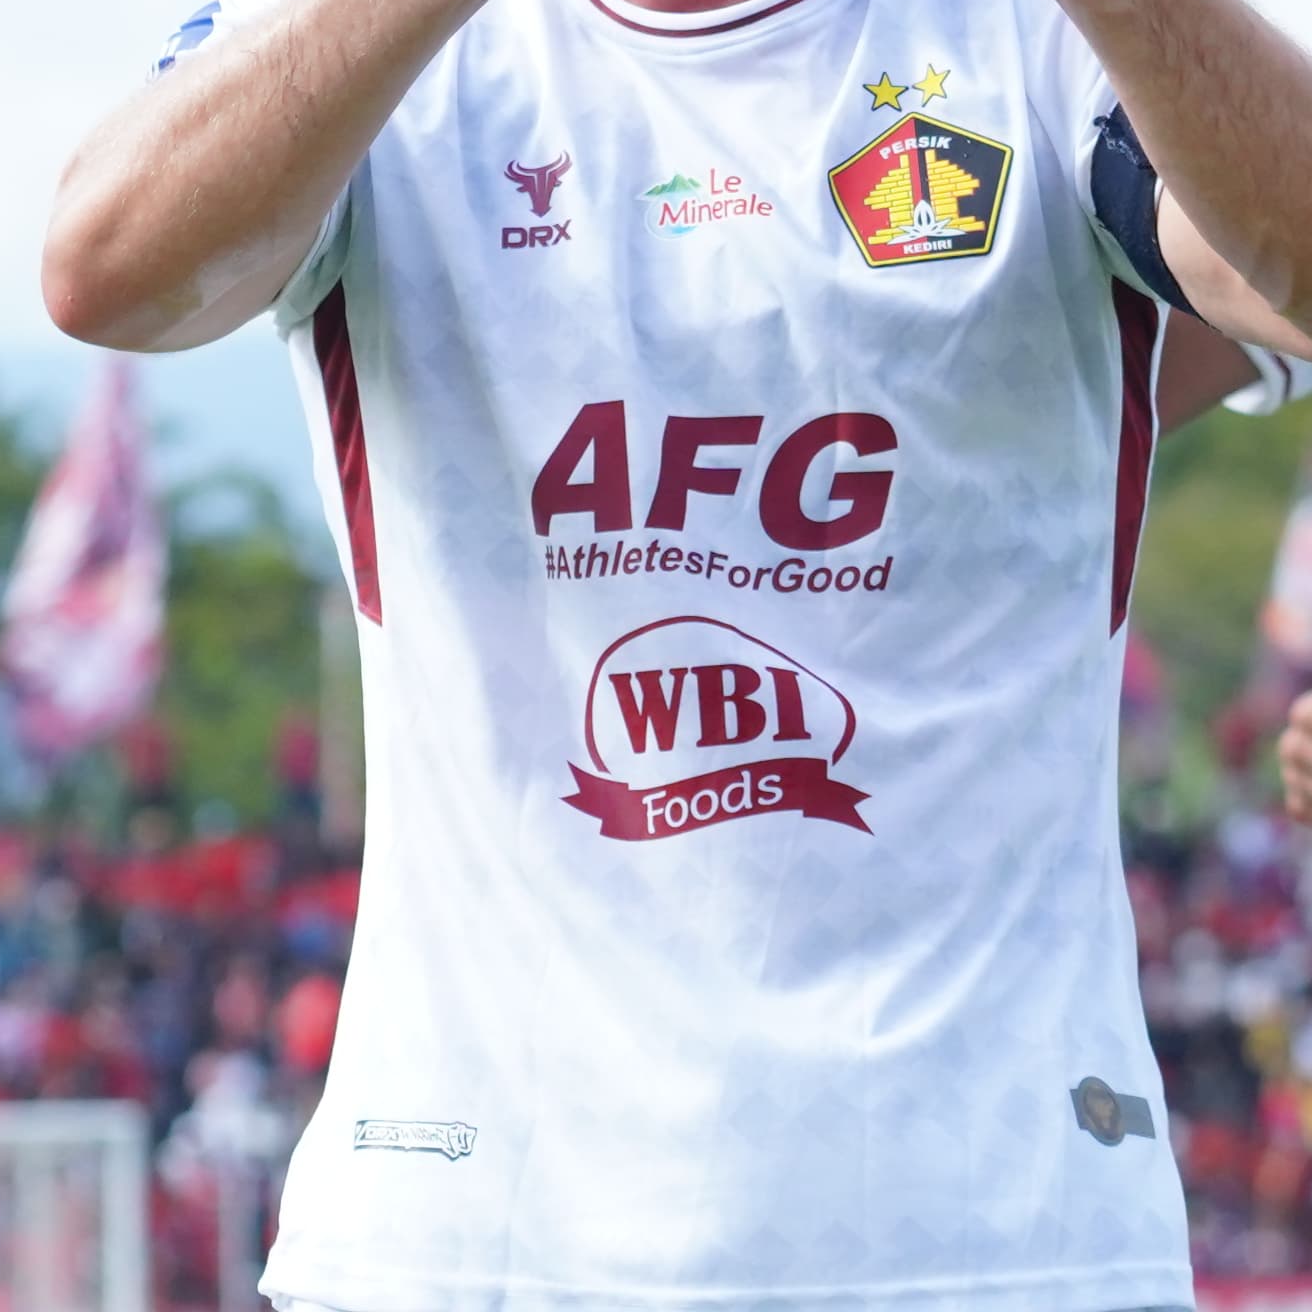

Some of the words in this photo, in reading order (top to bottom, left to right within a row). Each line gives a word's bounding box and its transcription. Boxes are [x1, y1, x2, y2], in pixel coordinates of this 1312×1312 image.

[879, 135, 952, 160] PERSIK
[710, 168, 742, 195] Le
[658, 196, 774, 227] Minerale
[501, 219, 572, 249] DRX
[903, 239, 953, 255] KEDIRI
[531, 399, 899, 552] AFG
[544, 538, 893, 594] #AthletesForGood
[608, 663, 812, 754] WBI
[641, 770, 785, 835] Foods
